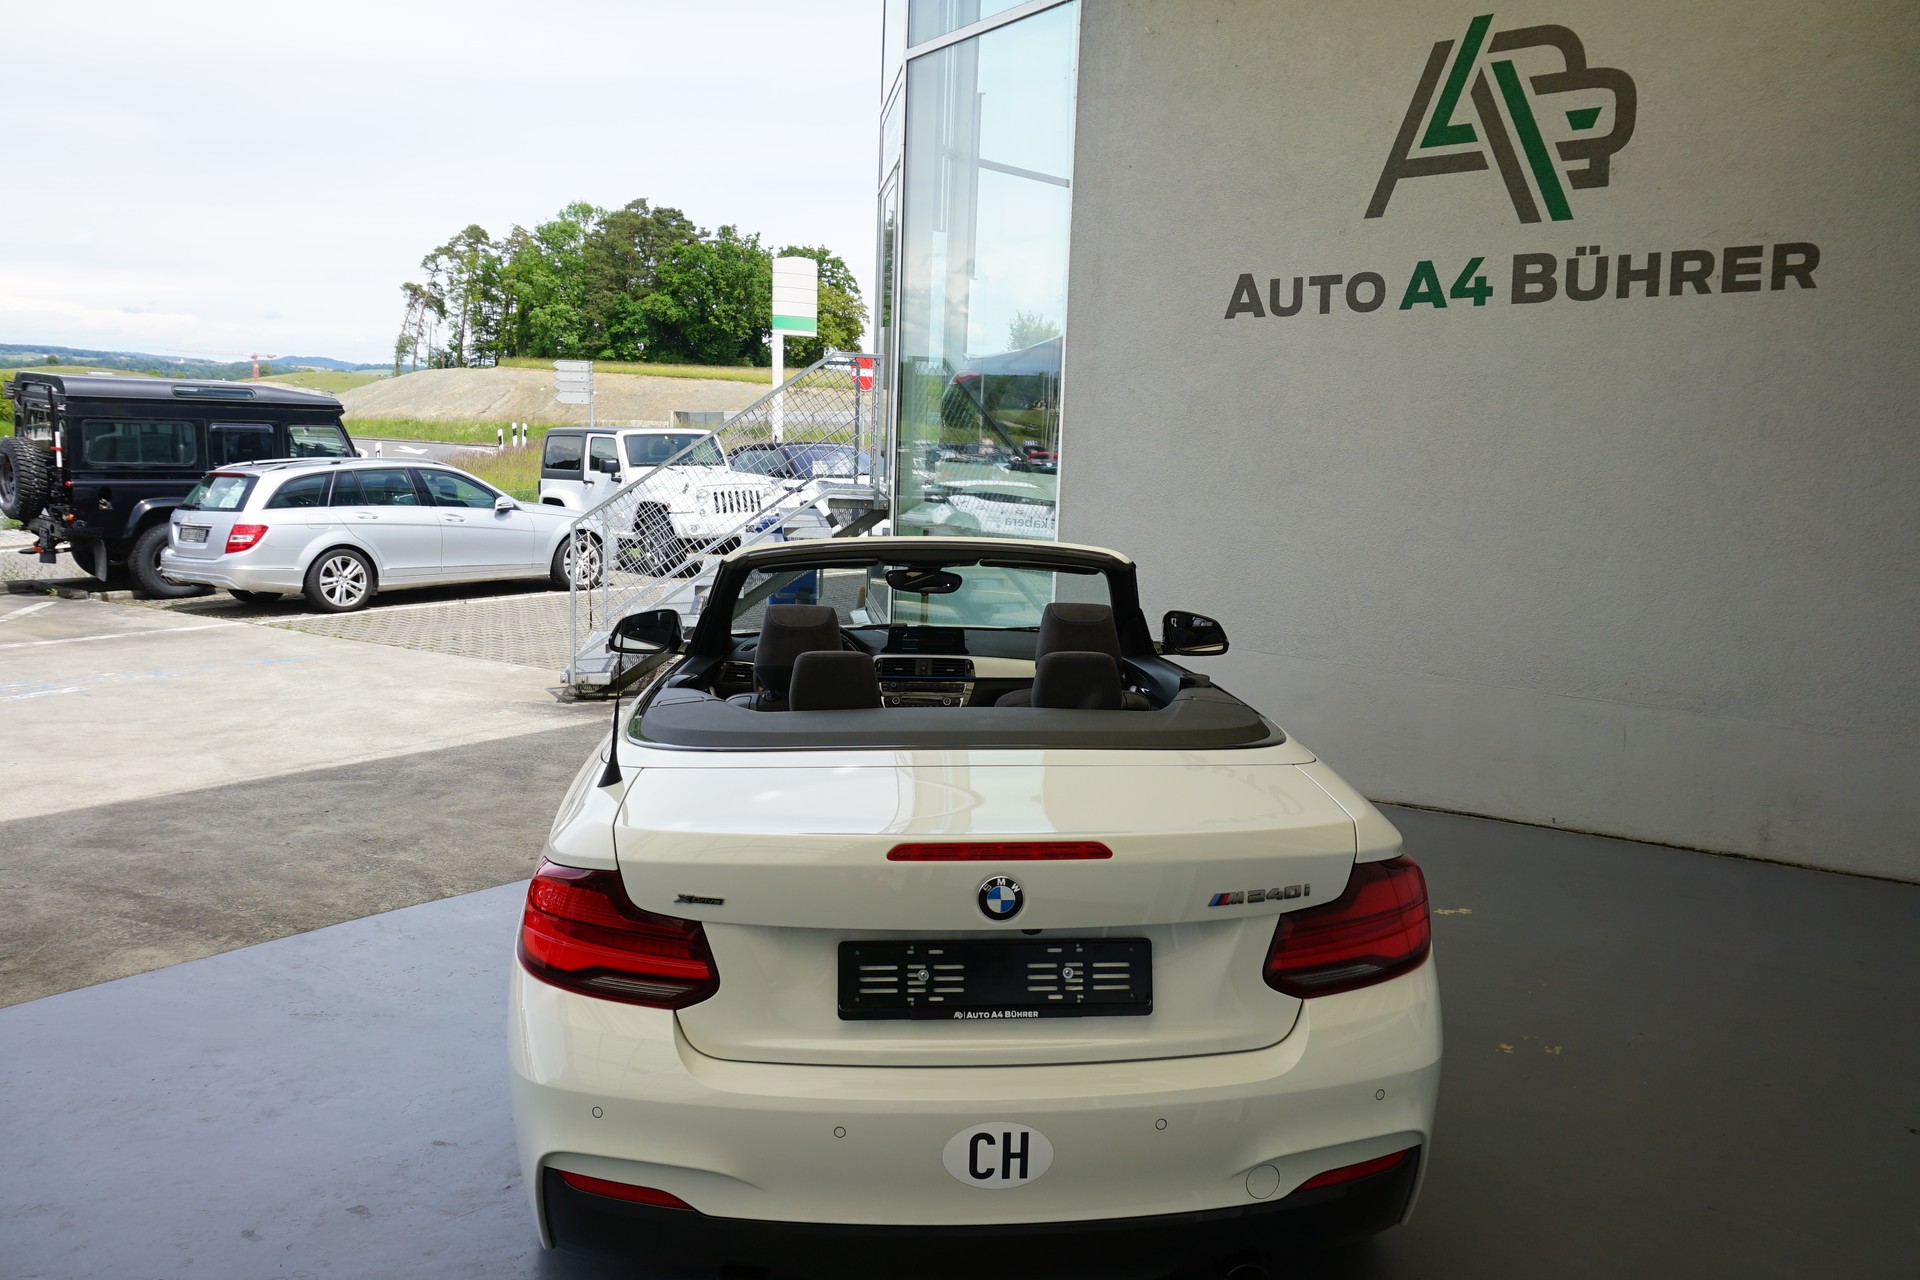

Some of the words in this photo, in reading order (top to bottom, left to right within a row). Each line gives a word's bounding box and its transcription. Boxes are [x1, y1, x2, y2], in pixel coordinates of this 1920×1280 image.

[1223, 271, 1387, 320] AUTO
[1398, 256, 1495, 311] A4
[1510, 242, 1821, 305] BÜHRER
[966, 1011, 990, 1019] AUTO
[991, 1010, 1004, 1018] A4
[1004, 1010, 1039, 1018] BÜHRER
[968, 1131, 1030, 1180] CH
